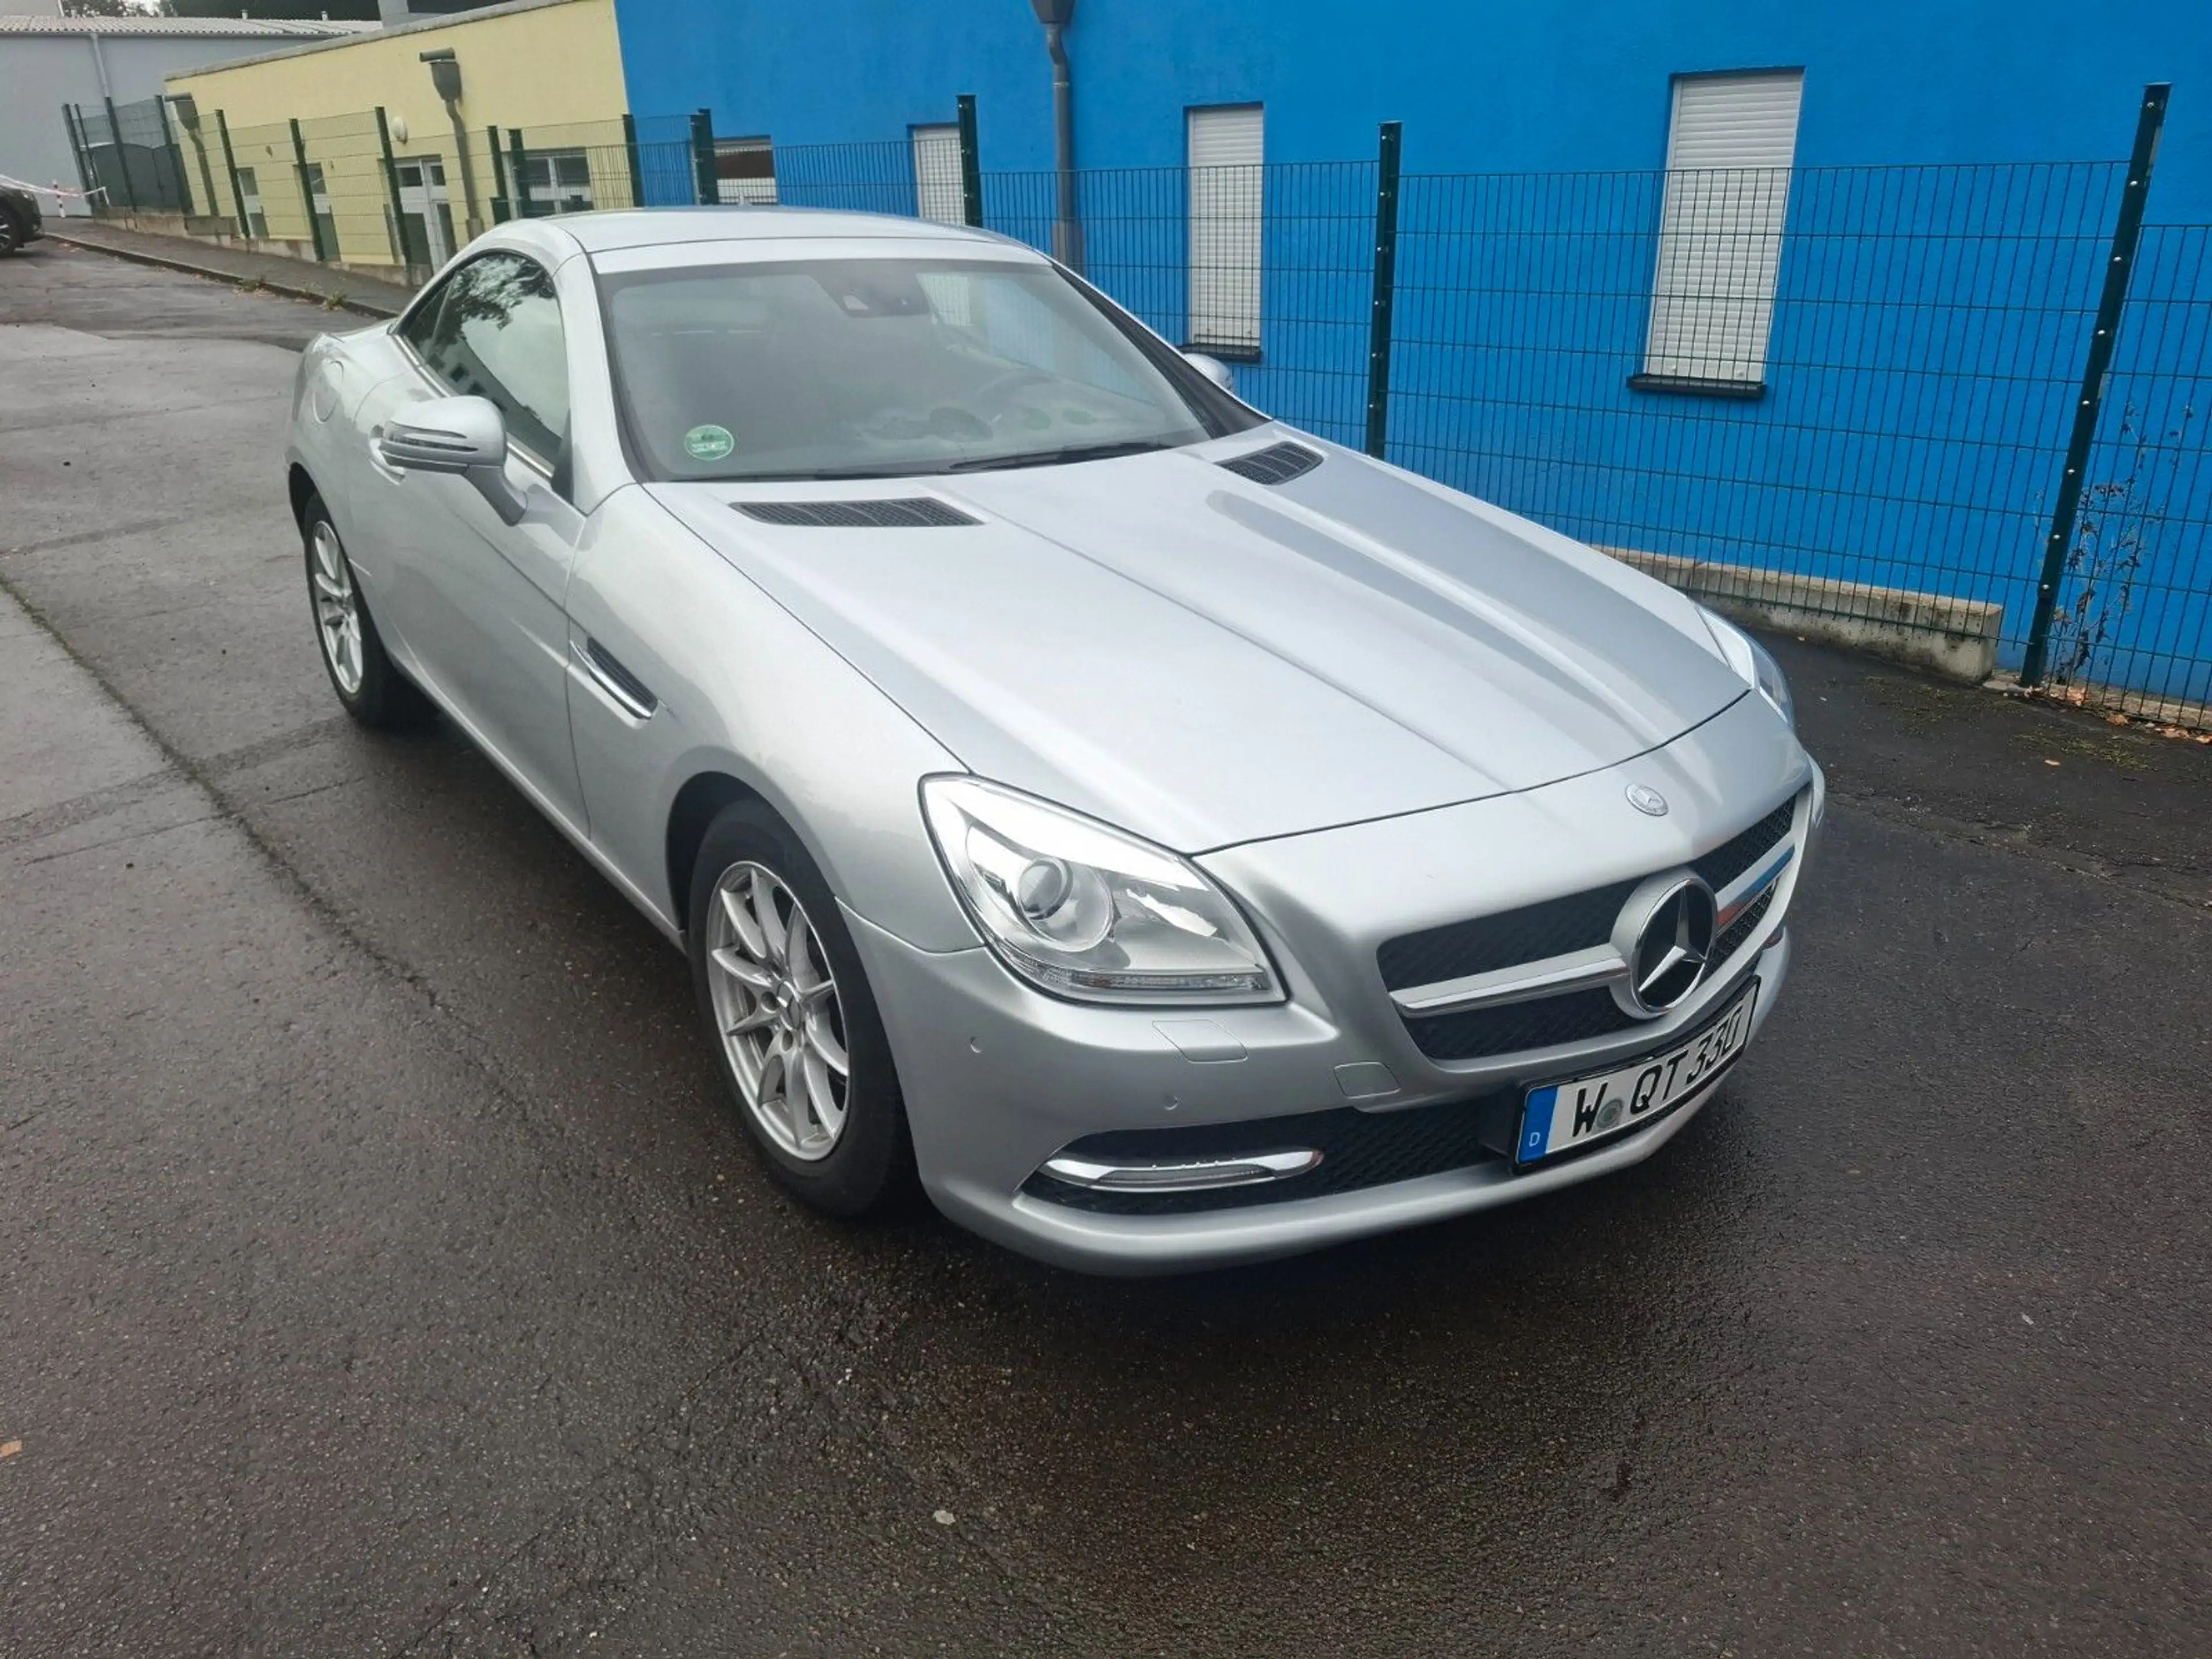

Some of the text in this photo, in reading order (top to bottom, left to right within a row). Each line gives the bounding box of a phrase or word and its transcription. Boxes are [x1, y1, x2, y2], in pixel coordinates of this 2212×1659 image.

[1572, 1004, 1743, 1138] W QT 330
[1529, 1132, 1541, 1147] D
